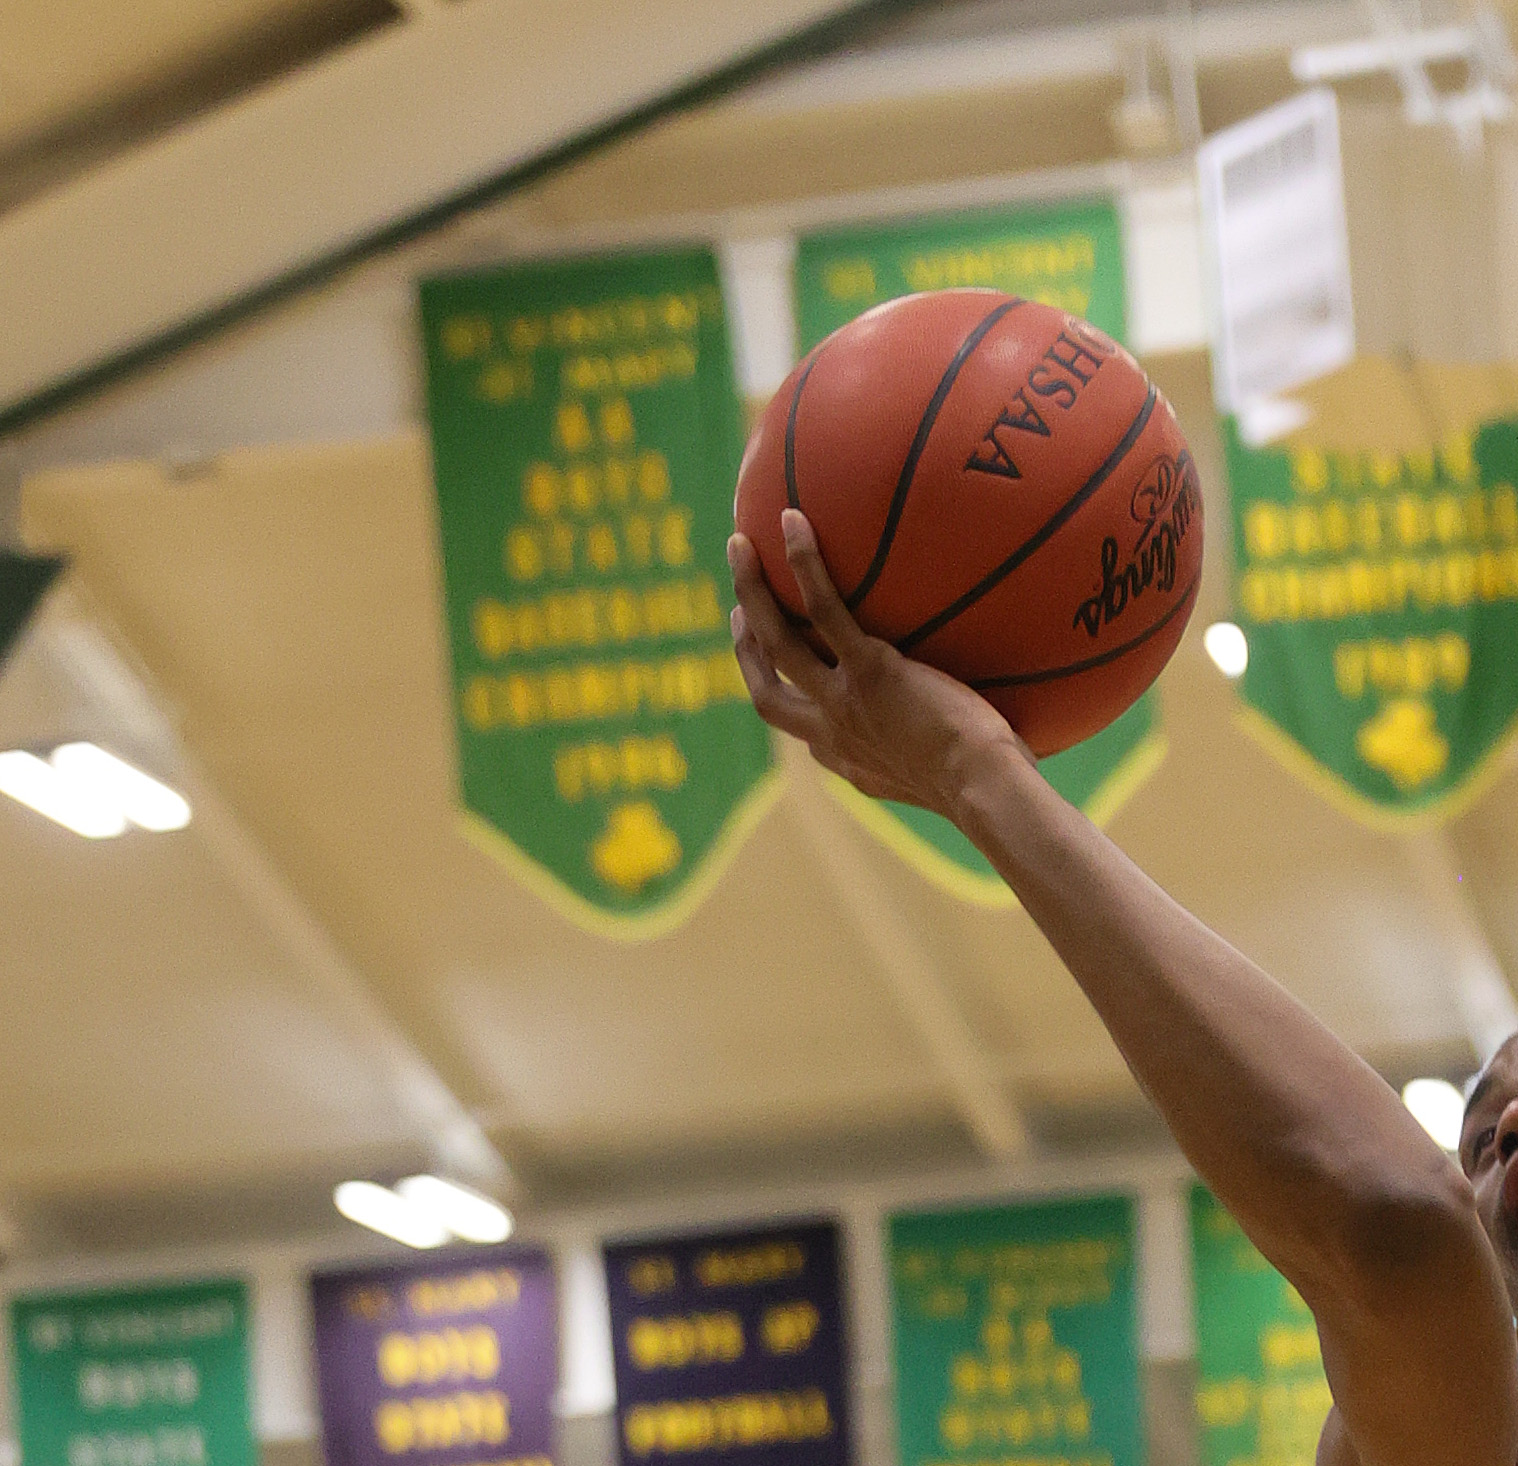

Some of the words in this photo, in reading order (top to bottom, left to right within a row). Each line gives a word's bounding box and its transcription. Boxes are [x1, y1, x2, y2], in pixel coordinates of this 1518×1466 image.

[510, 509, 689, 578] STATE
[1248, 488, 1518, 555] BASEBALL
[477, 573, 718, 653] BASEBALL
